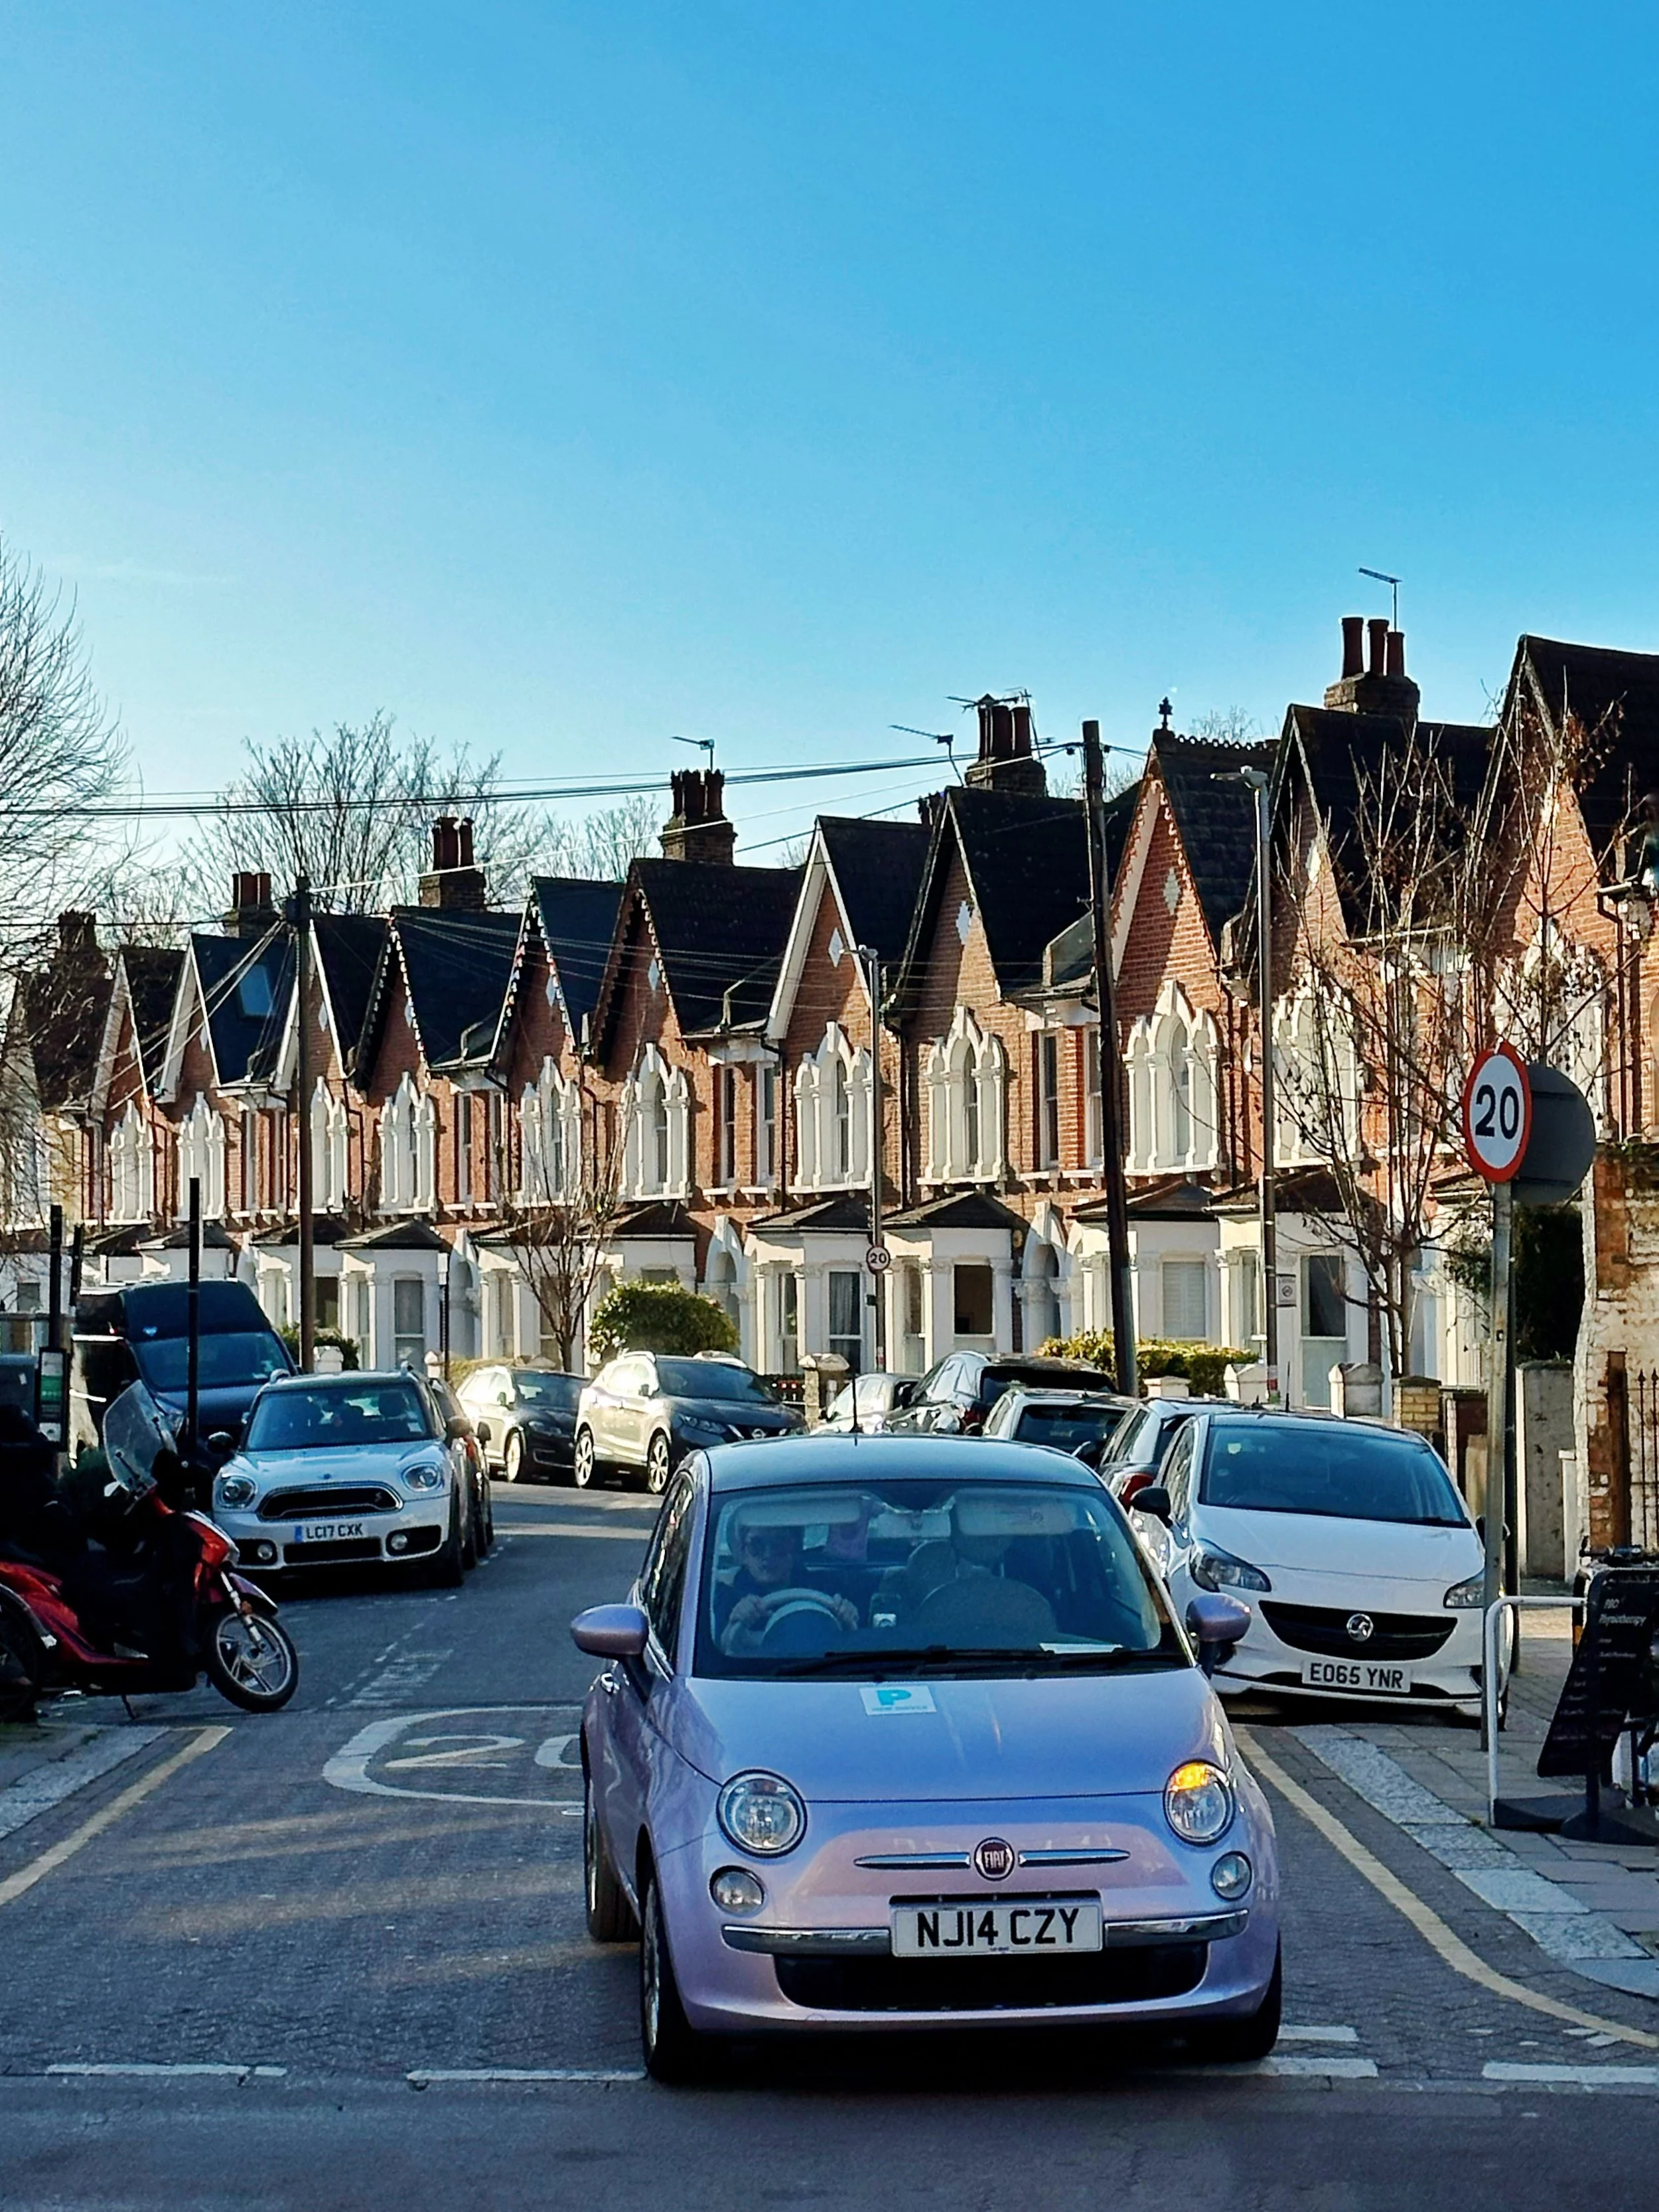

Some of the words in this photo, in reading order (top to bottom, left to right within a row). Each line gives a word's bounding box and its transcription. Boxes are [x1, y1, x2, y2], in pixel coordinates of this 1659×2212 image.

[1475, 1084, 1519, 1140] 20
[870, 1252, 887, 1264] 20
[306, 1525, 334, 1539] LC17
[338, 1522, 363, 1537] CXK
[1366, 1666, 1404, 1689] YNR
[877, 1690, 912, 1706] P
[983, 1850, 1005, 1869] FIAT
[917, 1910, 998, 1947] NJ14
[1010, 1908, 1079, 1945] CZY
